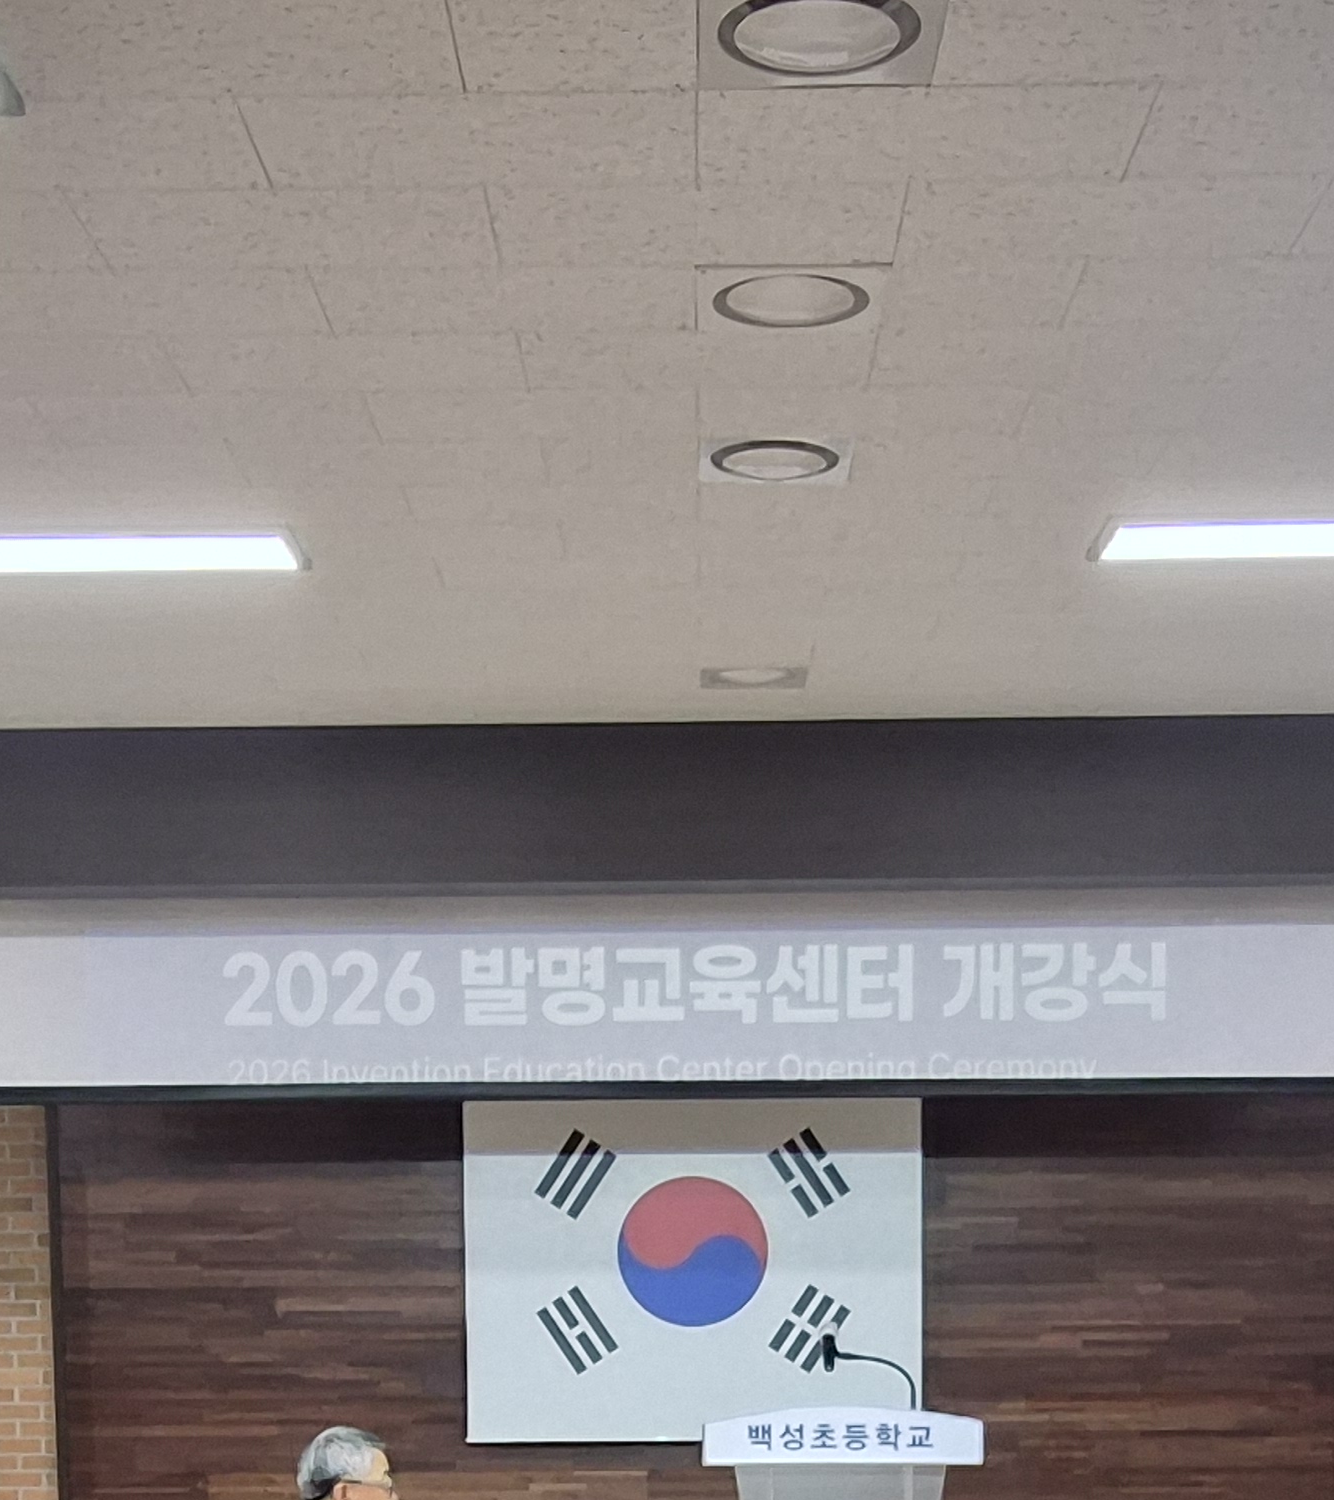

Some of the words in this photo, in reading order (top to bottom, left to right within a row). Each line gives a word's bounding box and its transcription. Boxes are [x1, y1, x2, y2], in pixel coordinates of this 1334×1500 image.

[222, 949, 436, 1027] 2026
[460, 943, 915, 1026] 발명교육센터
[943, 941, 1168, 1022] 개강식
[228, 1058, 311, 1083] 2026
[323, 1055, 471, 1082] Invention
[483, 1053, 646, 1082] Education
[657, 1052, 767, 1081] Center
[747, 1423, 934, 1451] 백성초등학교
